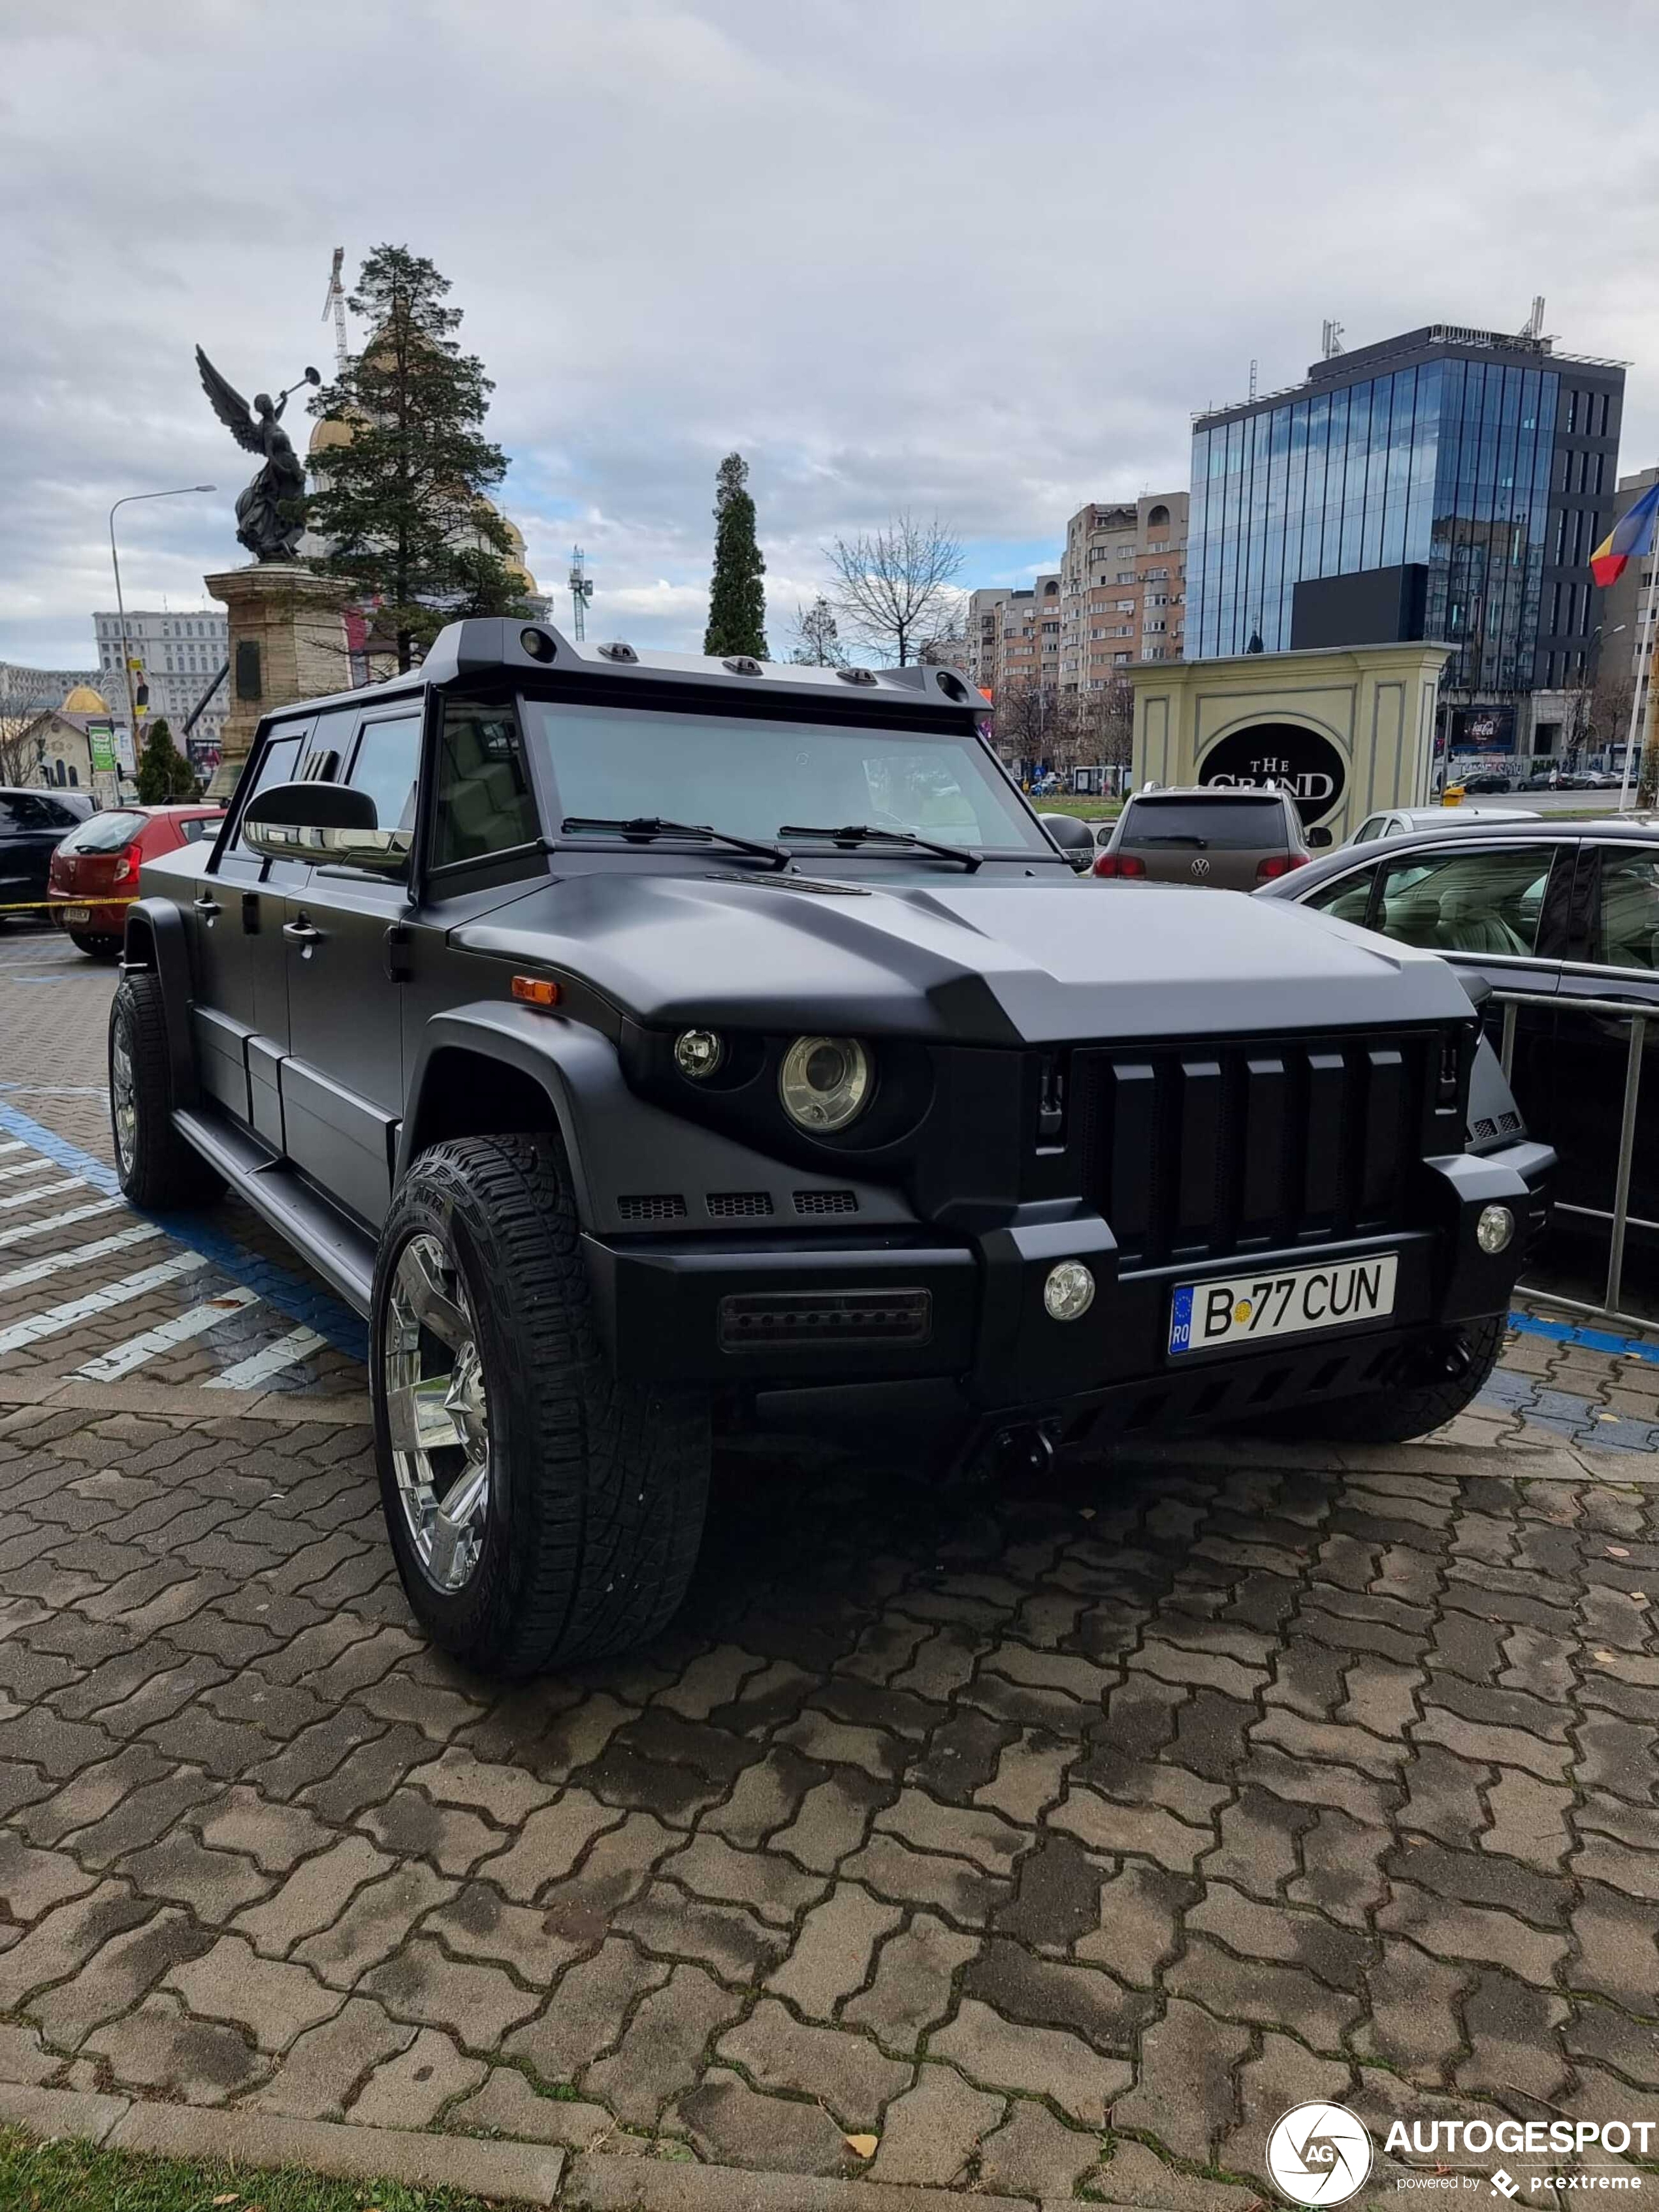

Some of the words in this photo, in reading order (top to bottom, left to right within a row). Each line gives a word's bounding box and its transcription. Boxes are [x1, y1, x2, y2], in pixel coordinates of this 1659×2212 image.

[1250, 758, 1289, 773] THE
[1204, 1288, 1234, 1338] B
[1248, 1278, 1296, 1331] 77
[1303, 1265, 1381, 1320] CUN
[1173, 1323, 1189, 1343] RO
